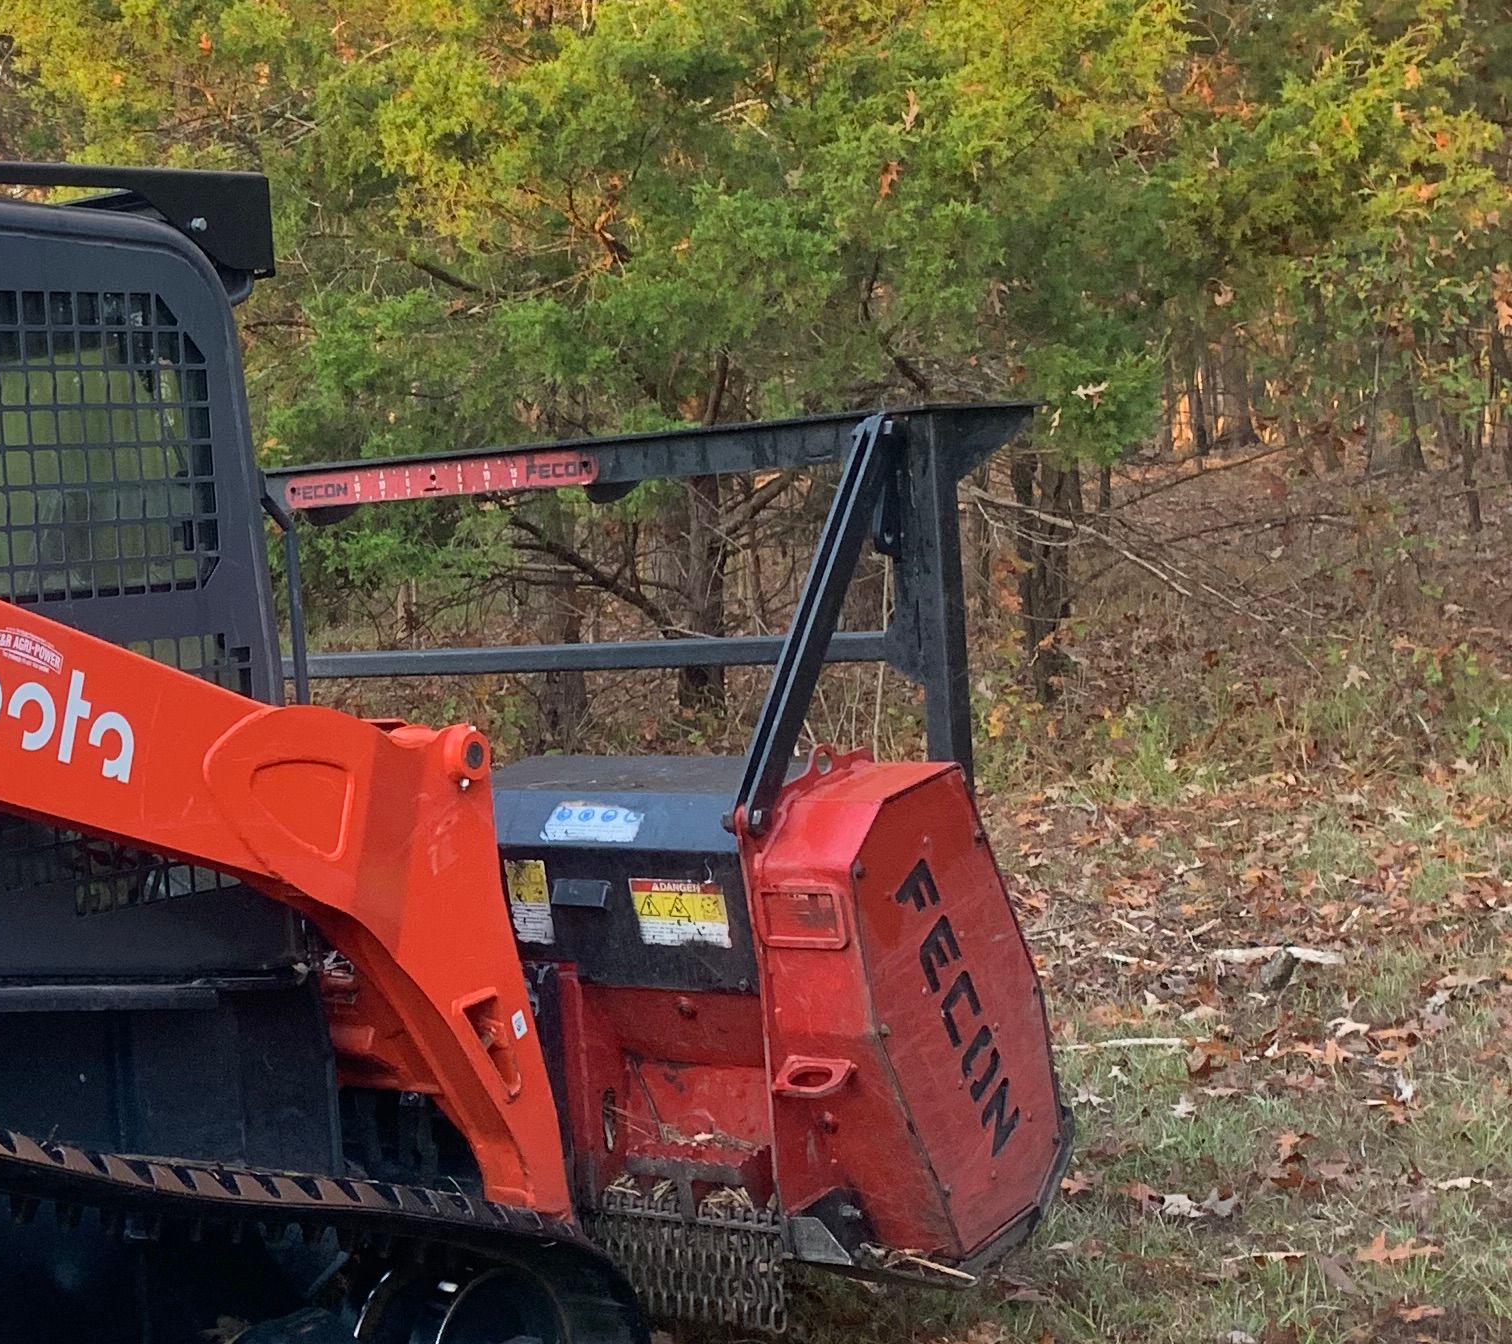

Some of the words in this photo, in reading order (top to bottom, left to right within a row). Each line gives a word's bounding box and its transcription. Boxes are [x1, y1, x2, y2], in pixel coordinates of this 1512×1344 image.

[290, 483, 348, 501] FECON
[12, 636, 61, 670] AGRI-POWER
[895, 858, 1021, 1157] FECON
